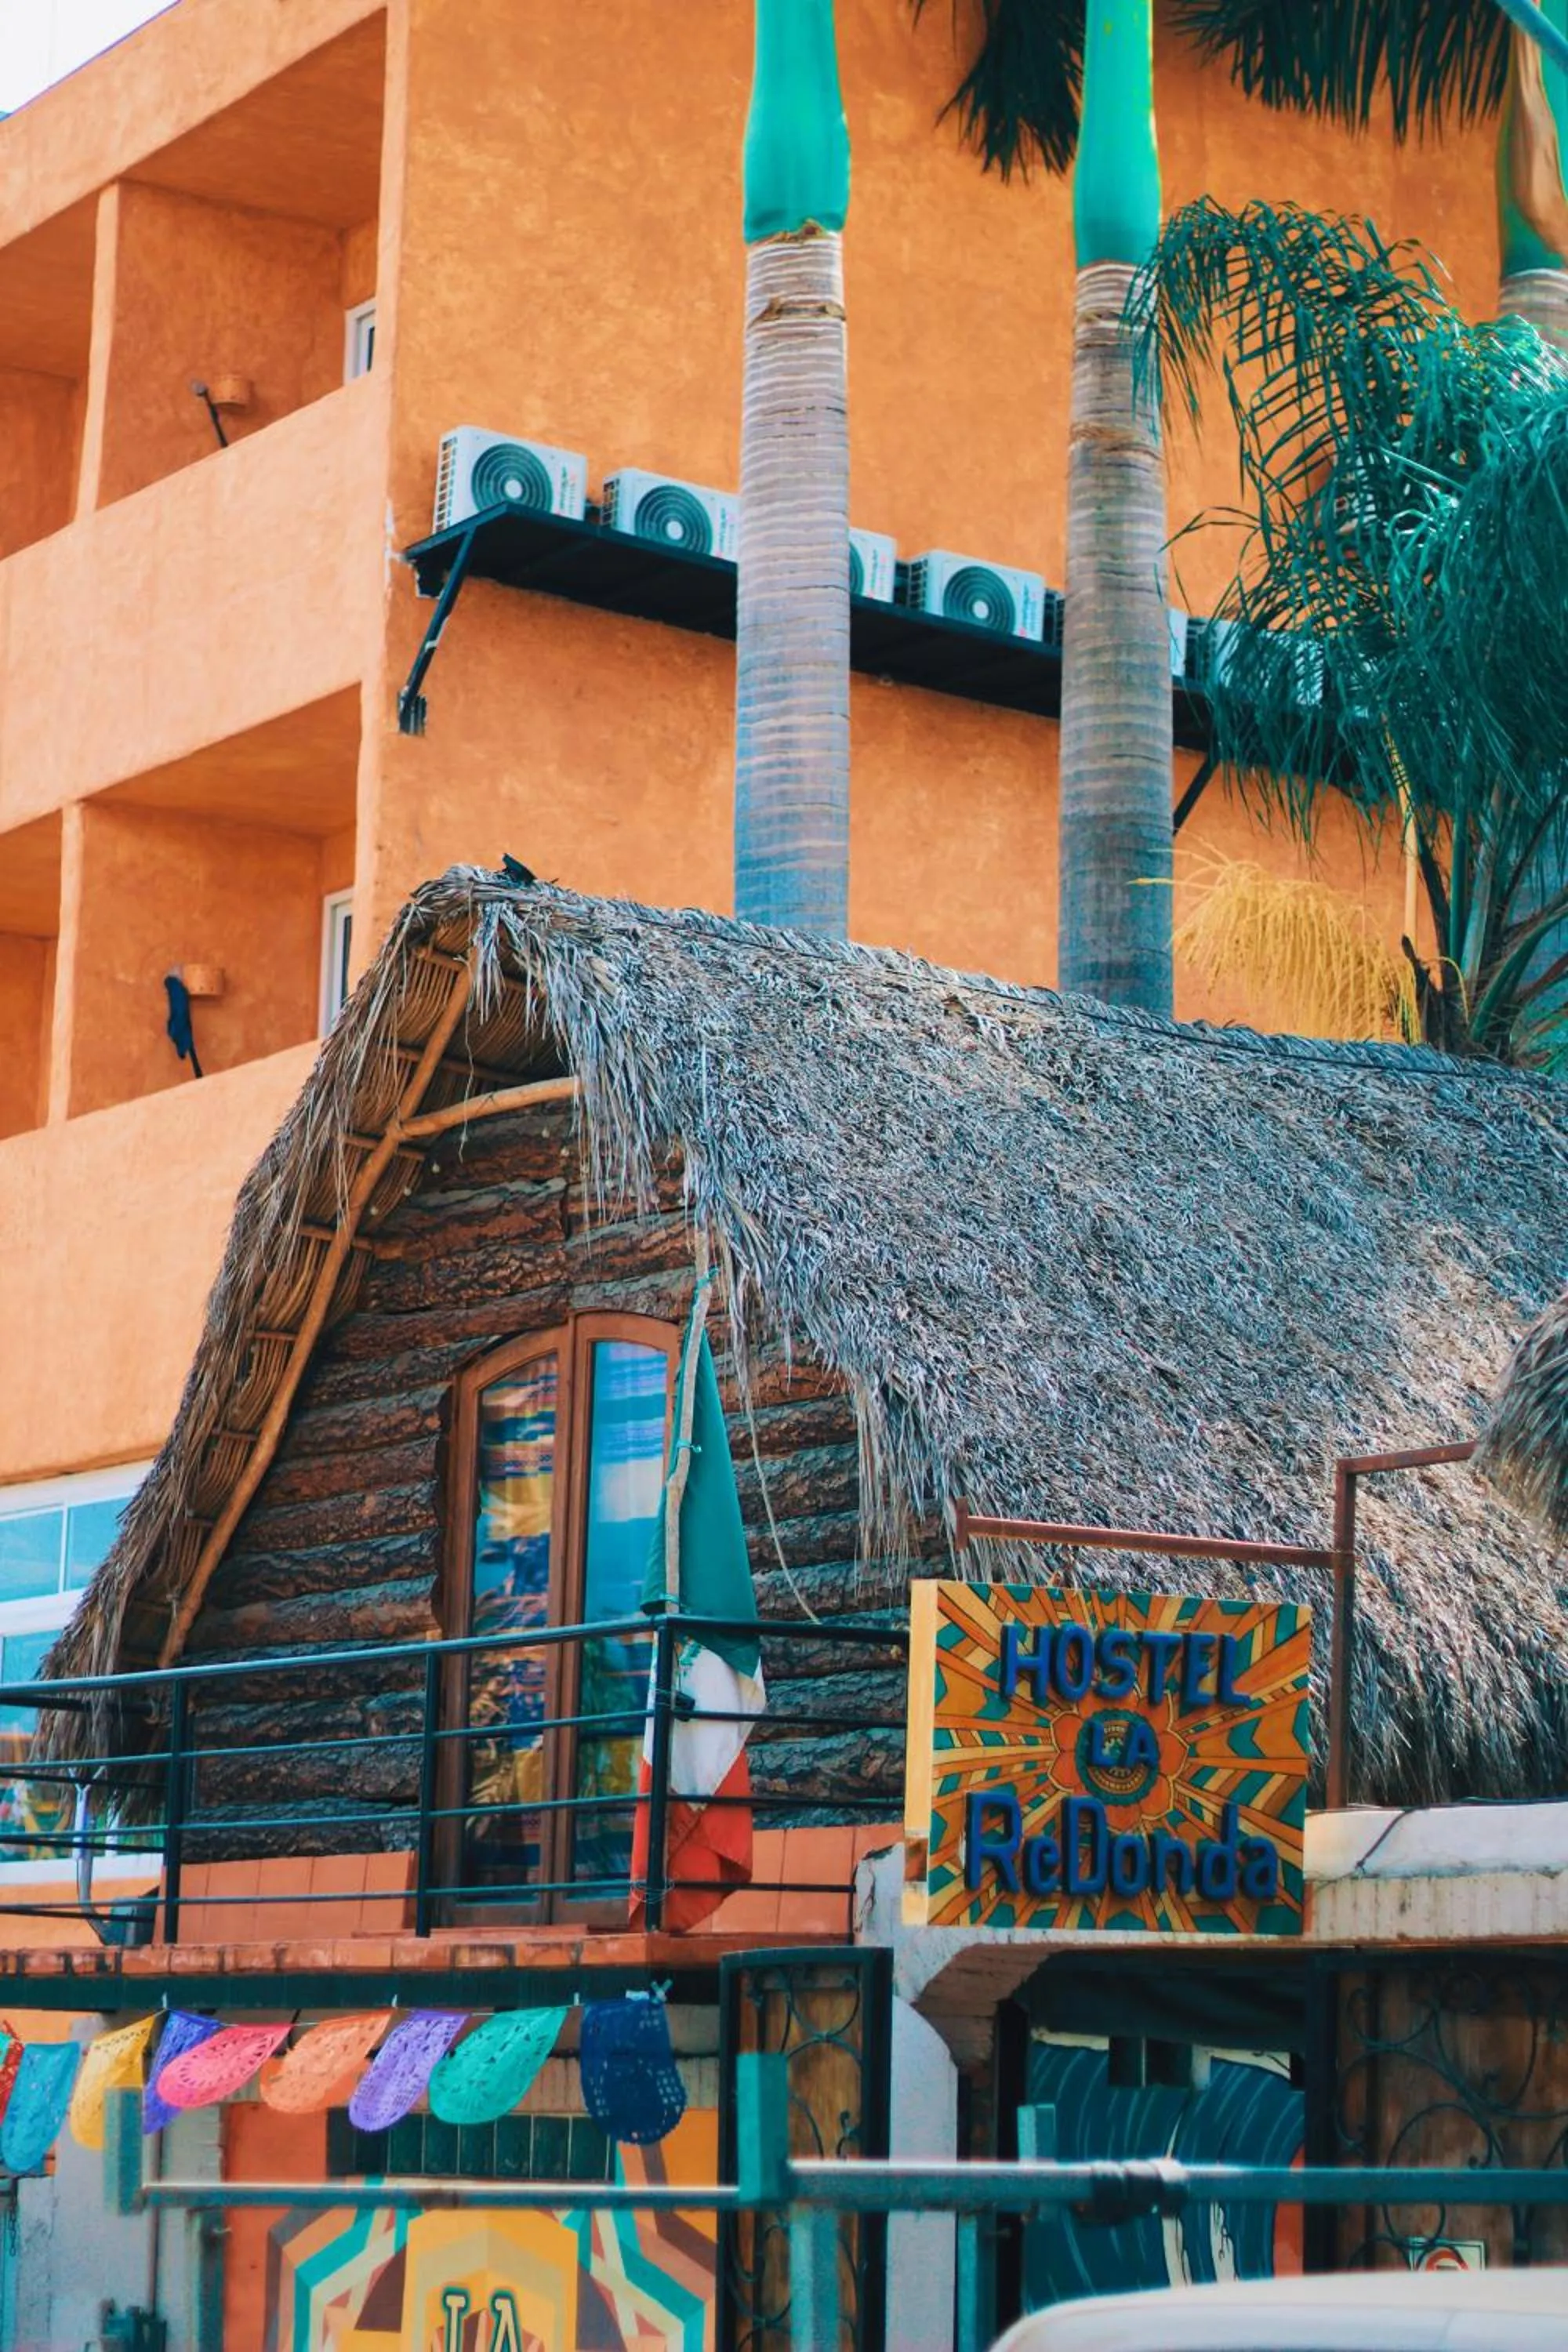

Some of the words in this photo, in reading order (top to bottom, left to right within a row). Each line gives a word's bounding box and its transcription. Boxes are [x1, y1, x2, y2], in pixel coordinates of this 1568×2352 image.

[1001, 1623, 1251, 1708] HOSTEL
[1087, 1718, 1159, 1768] LA
[965, 1791, 1278, 1900] ReDonda
